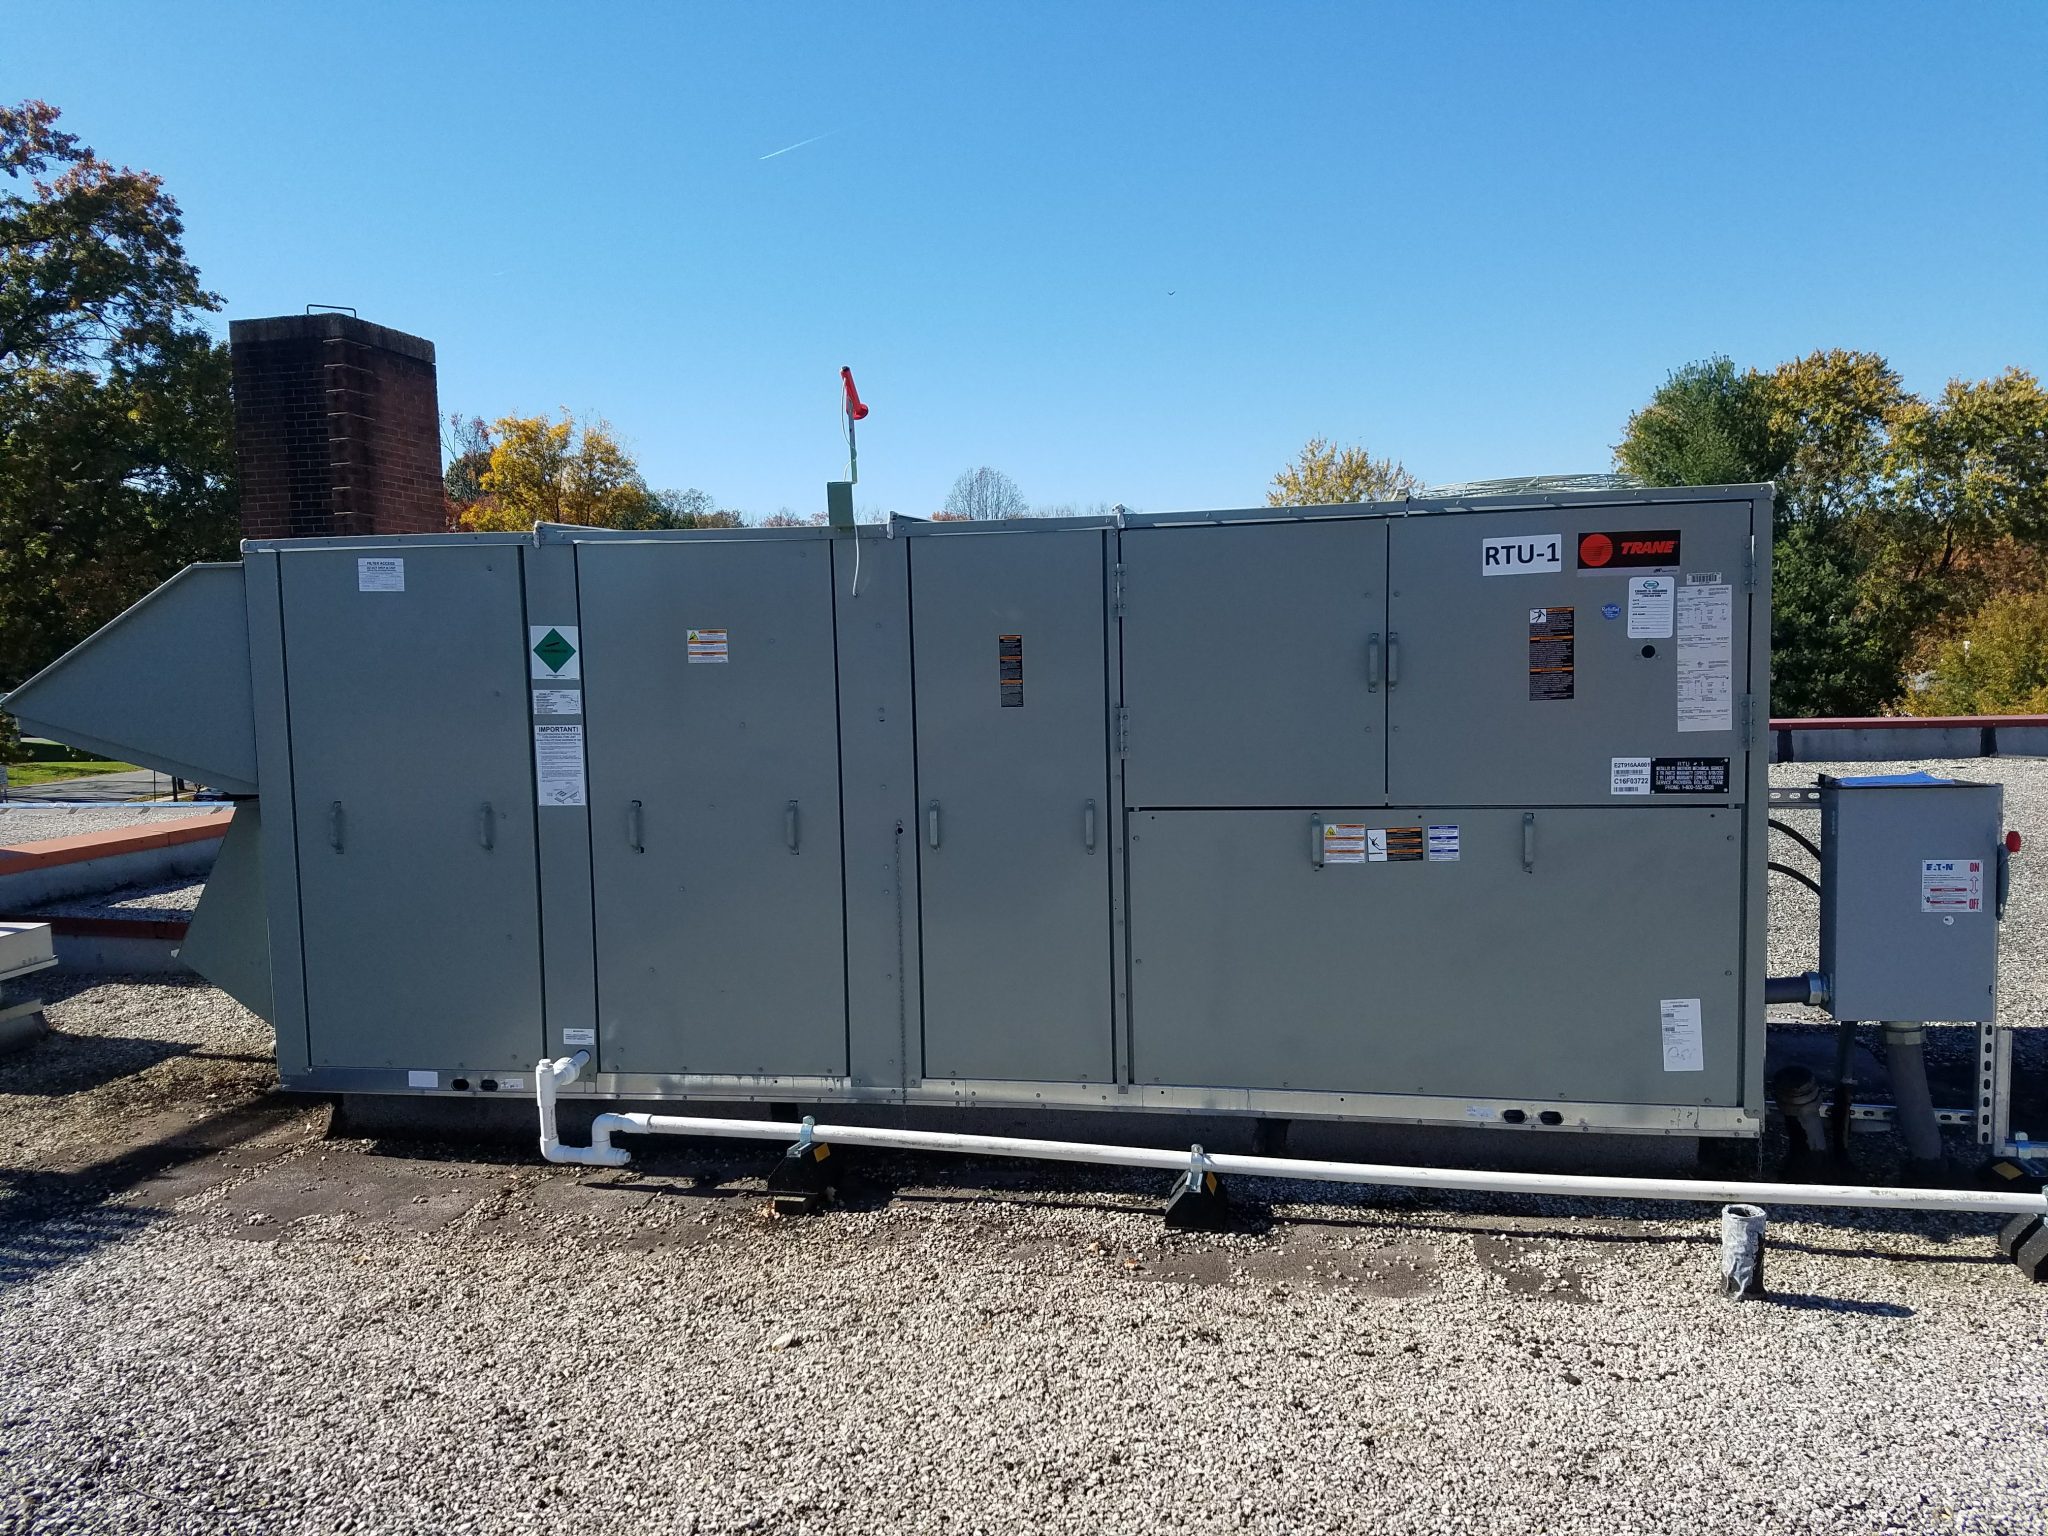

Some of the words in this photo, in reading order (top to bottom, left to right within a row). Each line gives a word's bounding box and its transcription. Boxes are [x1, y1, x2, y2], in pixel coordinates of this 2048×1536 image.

[1621, 541, 1675, 555] TRANE
[1485, 543, 1560, 566] RTU-1
[1969, 862, 1980, 872] ON
[1968, 898, 1980, 909] OFF
